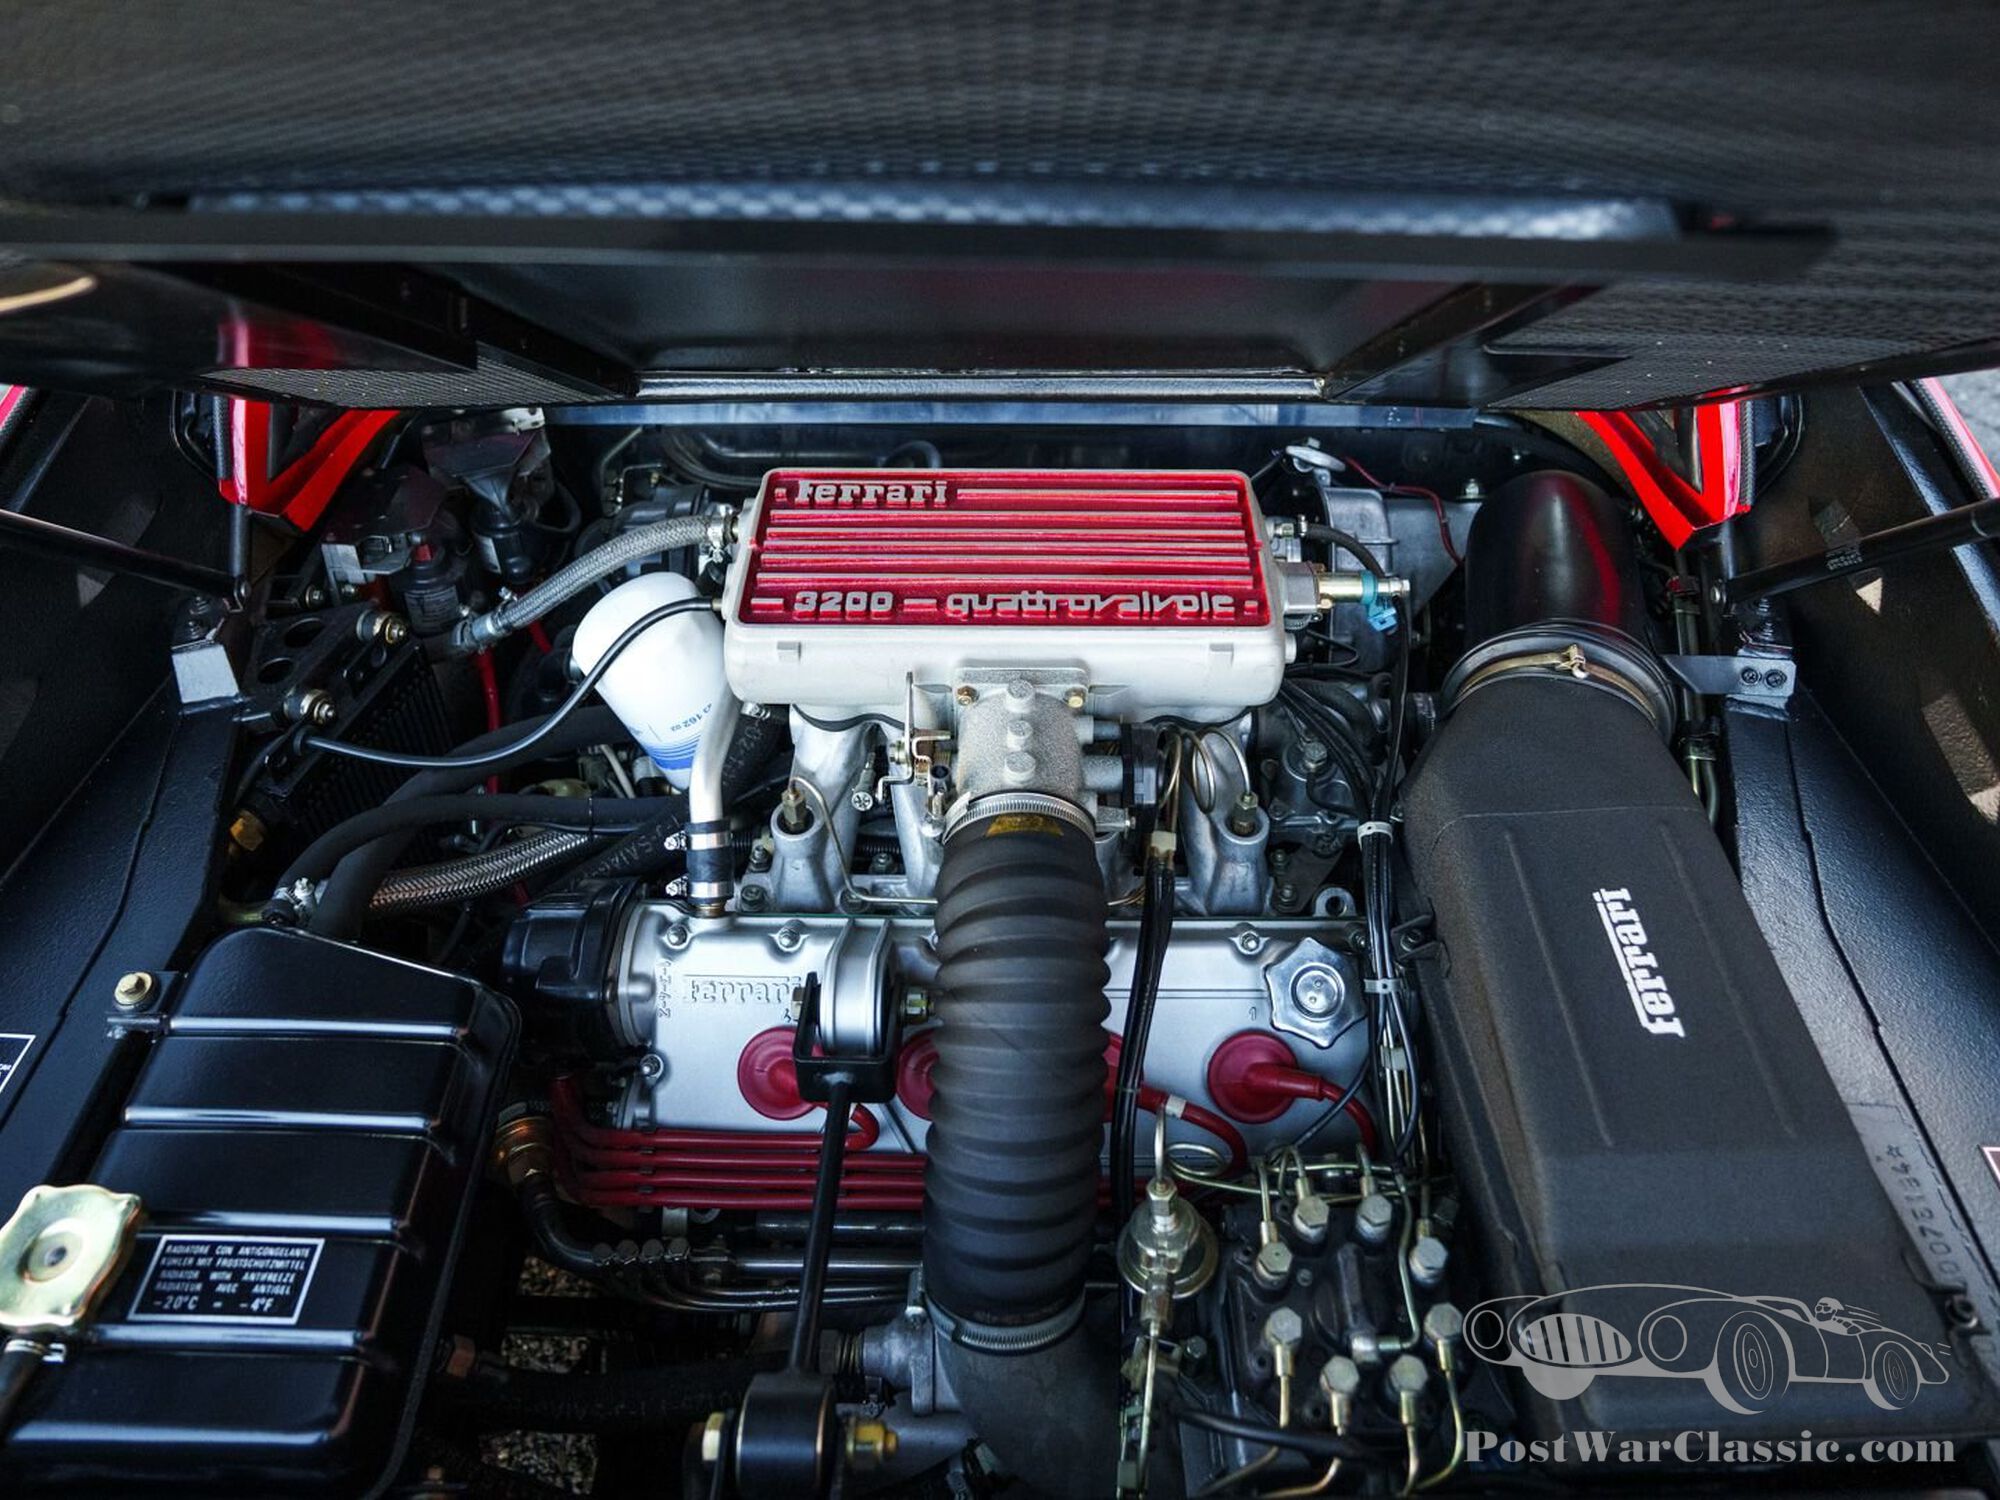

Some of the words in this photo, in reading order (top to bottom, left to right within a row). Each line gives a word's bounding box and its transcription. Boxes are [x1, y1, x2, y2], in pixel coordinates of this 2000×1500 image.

[794, 479, 948, 508] Ferrari
[793, 590, 894, 620] 3200
[945, 590, 1235, 621] quattrovalvole
[1592, 887, 1685, 1038] Ferrari
[215, 1245, 234, 1255] CON
[237, 1246, 311, 1258] ANTICONGELANTE
